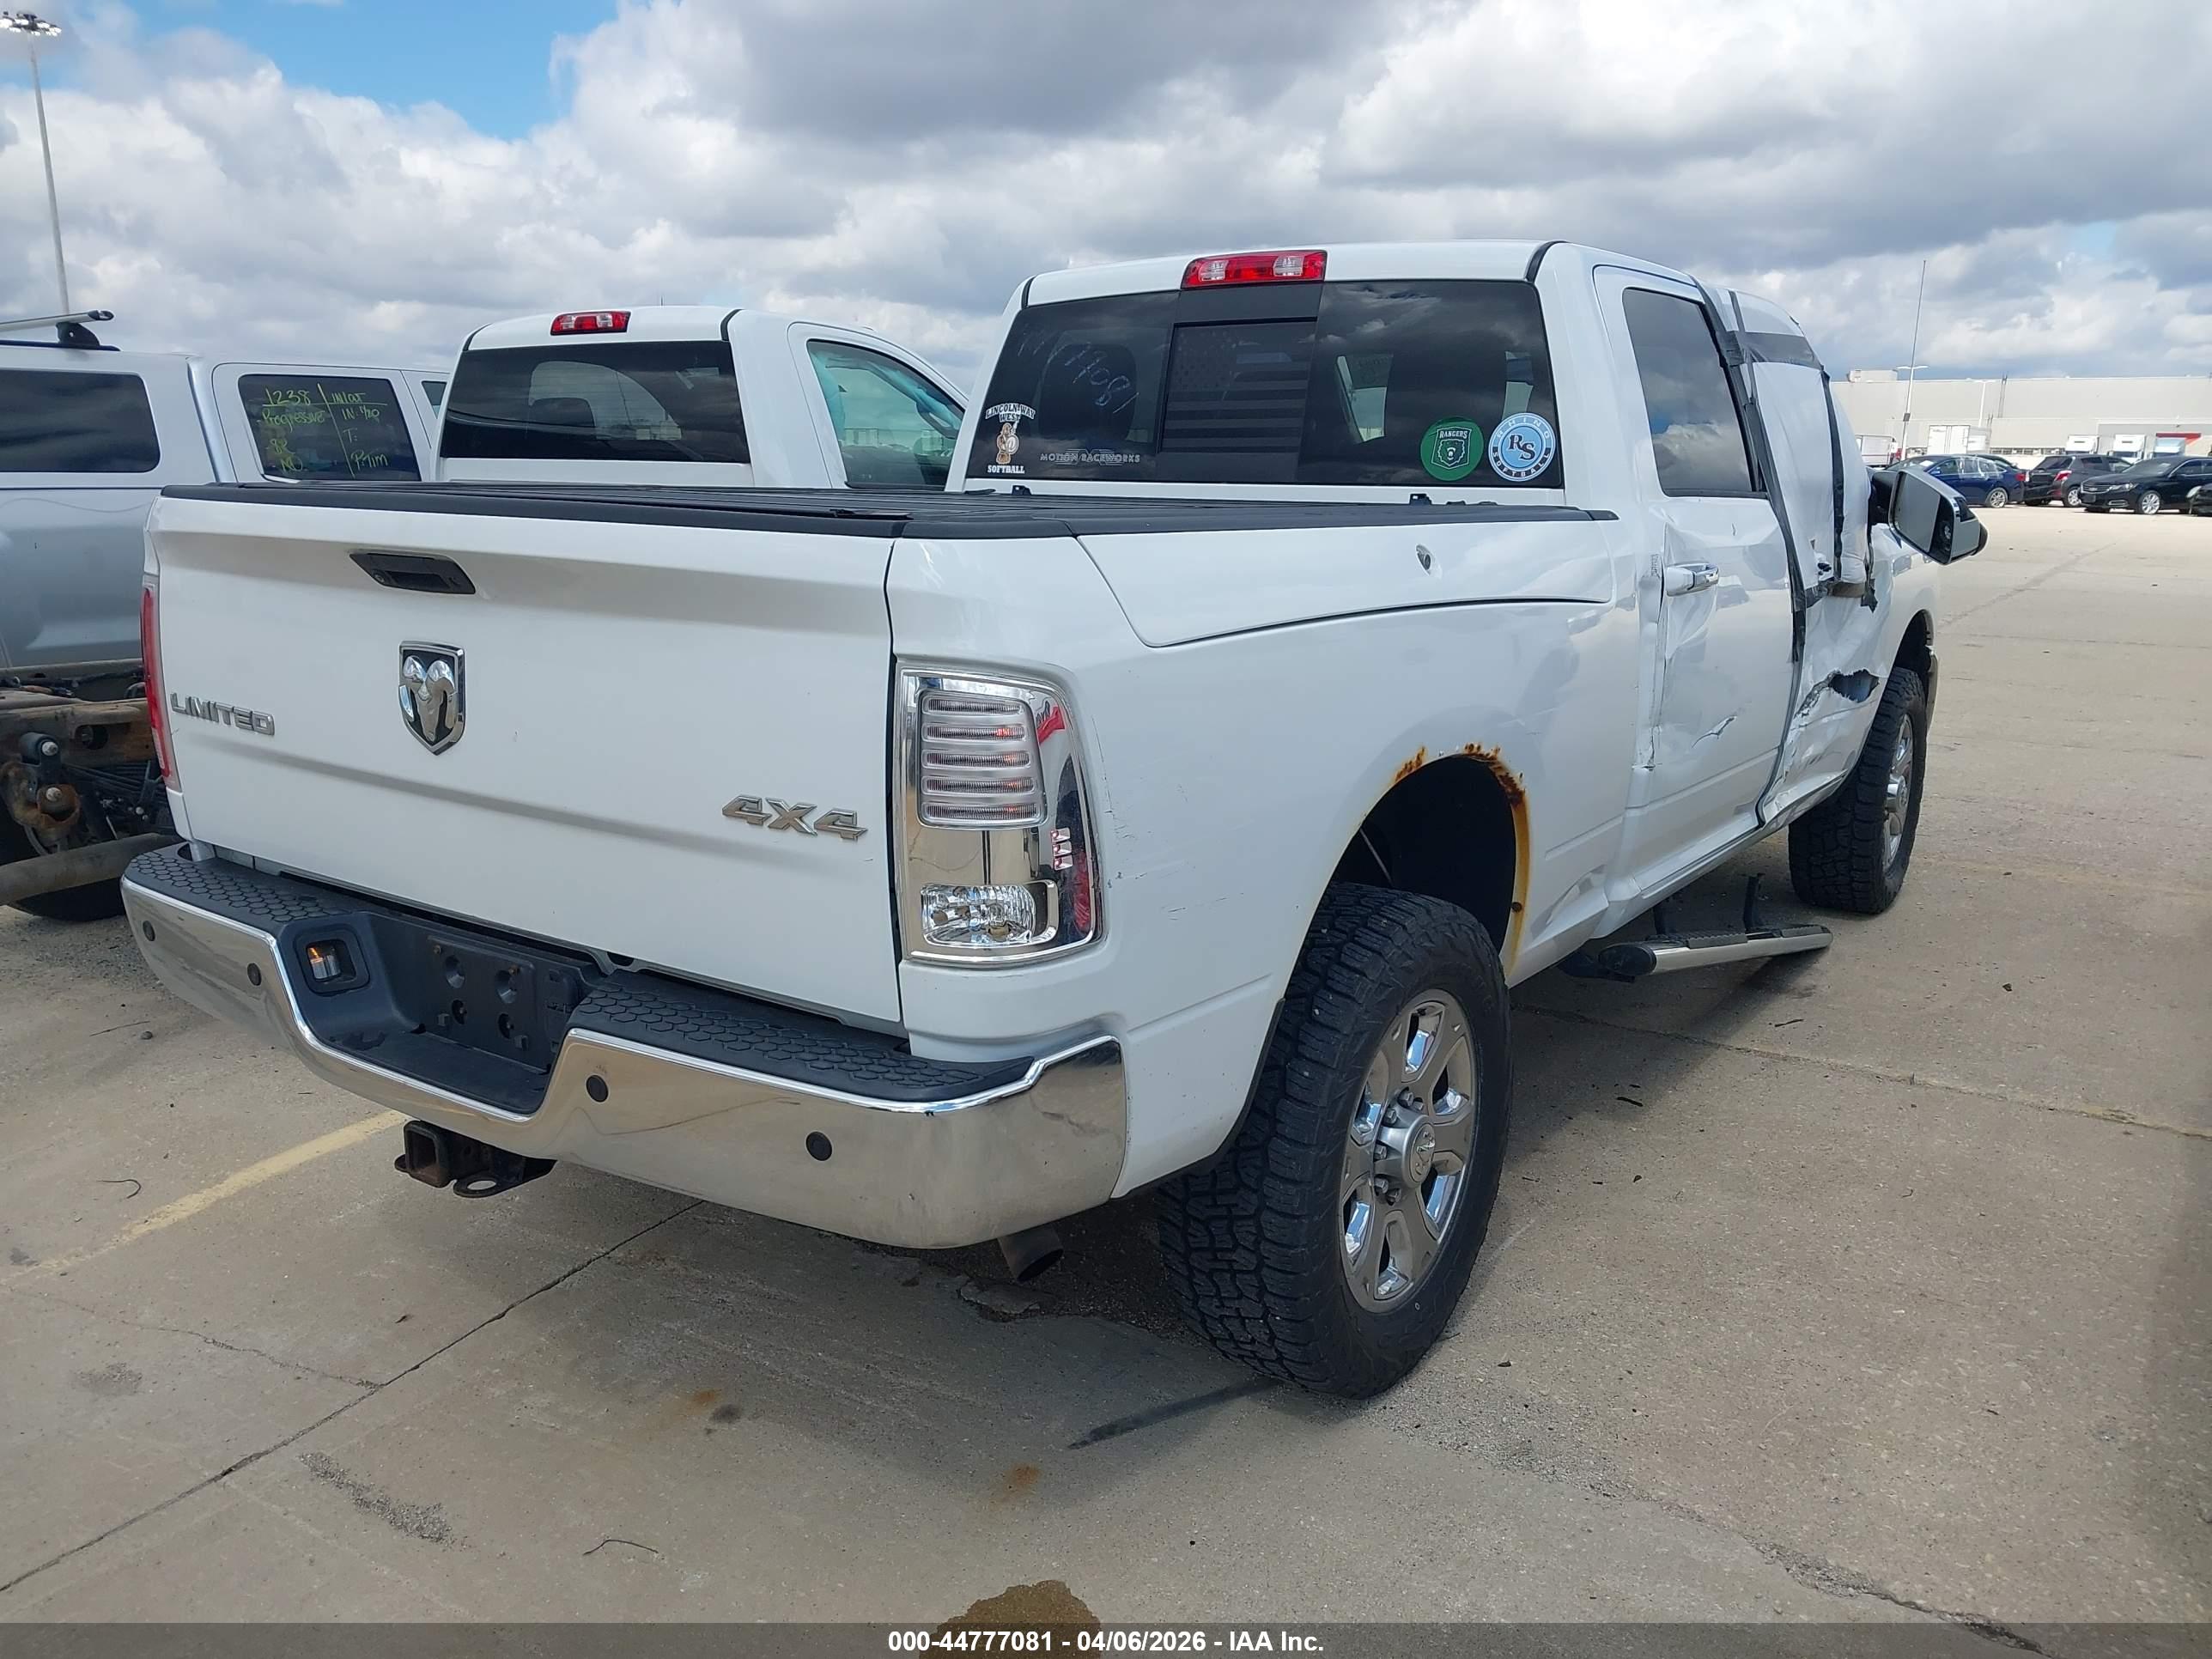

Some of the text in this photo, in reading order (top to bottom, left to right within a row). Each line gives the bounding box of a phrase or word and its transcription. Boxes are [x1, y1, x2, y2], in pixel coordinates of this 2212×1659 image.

[264, 388, 312, 406] 1238
[1000, 411, 1020, 422] WEST
[1439, 430, 1468, 440] RANGERS
[1496, 417, 1551, 440] RHINO
[1508, 434, 1537, 461] RS
[1039, 453, 1140, 463] MOTION RACEWORKS
[1492, 452, 1551, 478] SOFTBALL
[988, 465, 1025, 474] SOFTBALL
[170, 692, 276, 736] LIMITED
[722, 794, 869, 842] 4X4
